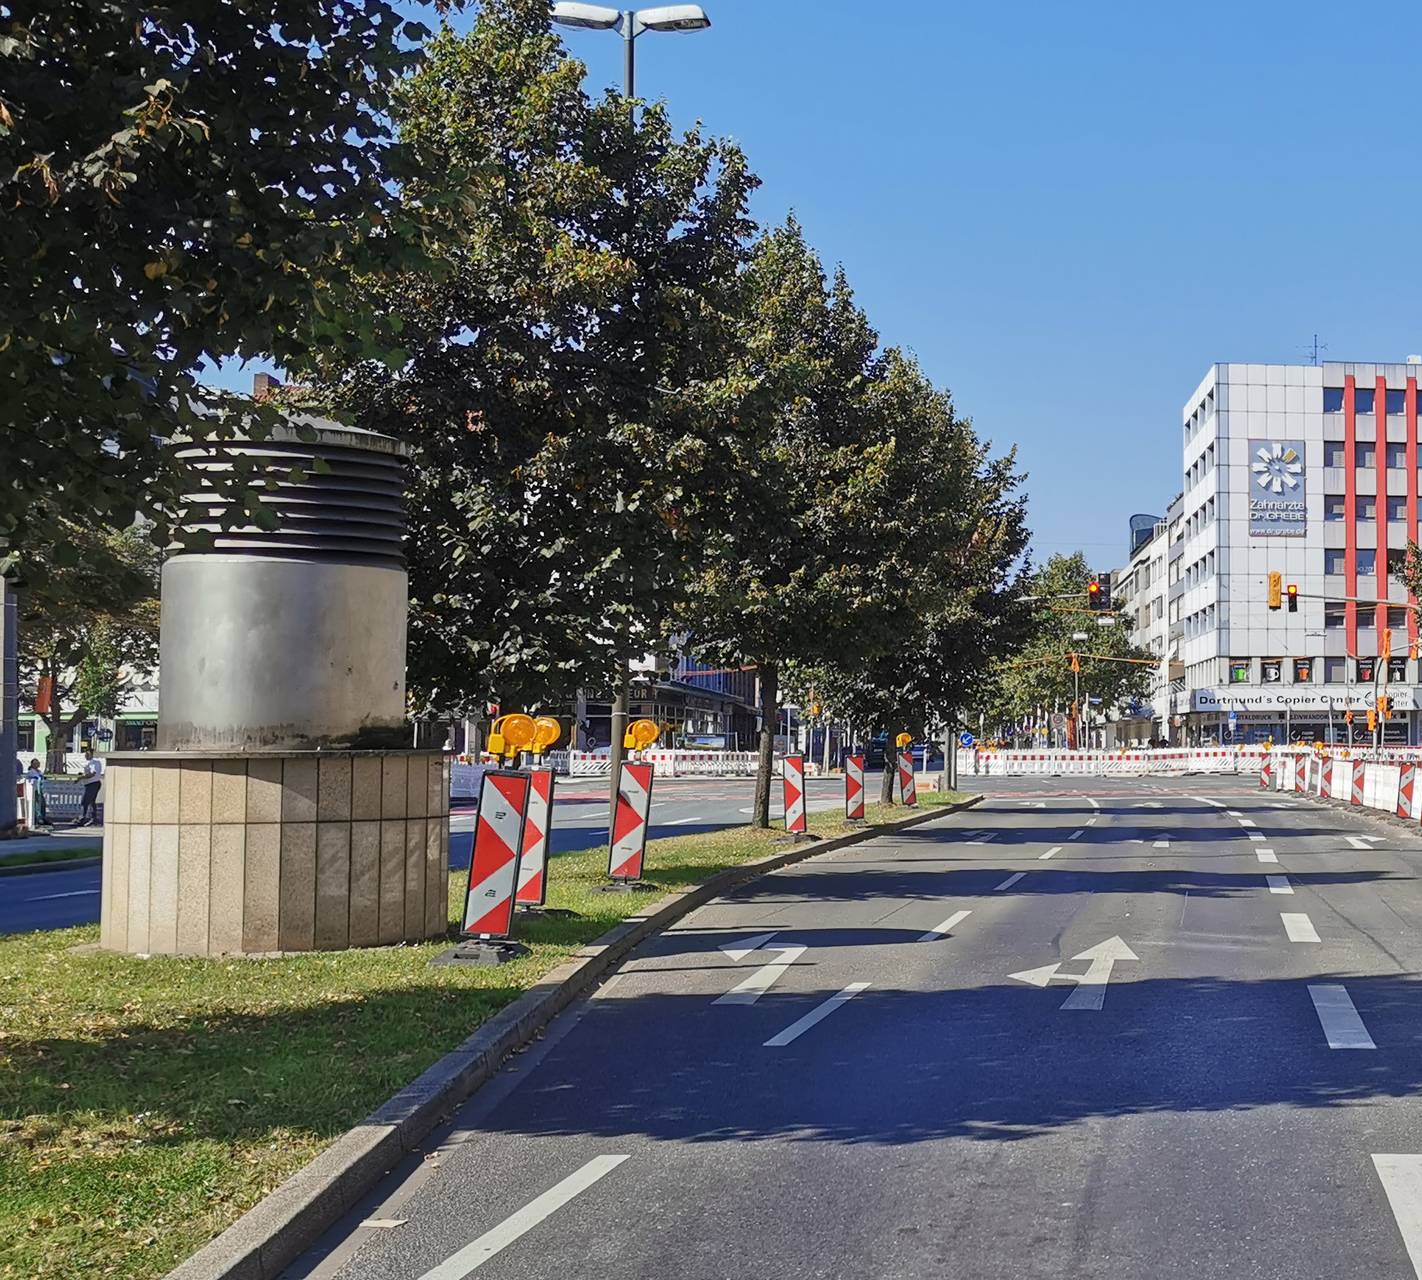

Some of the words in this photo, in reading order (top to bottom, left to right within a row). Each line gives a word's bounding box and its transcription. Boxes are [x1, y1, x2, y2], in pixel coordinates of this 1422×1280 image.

[1267, 511, 1304, 520] GREBE
[1276, 695, 1316, 707] Copier
[1320, 695, 1361, 704] Cener
